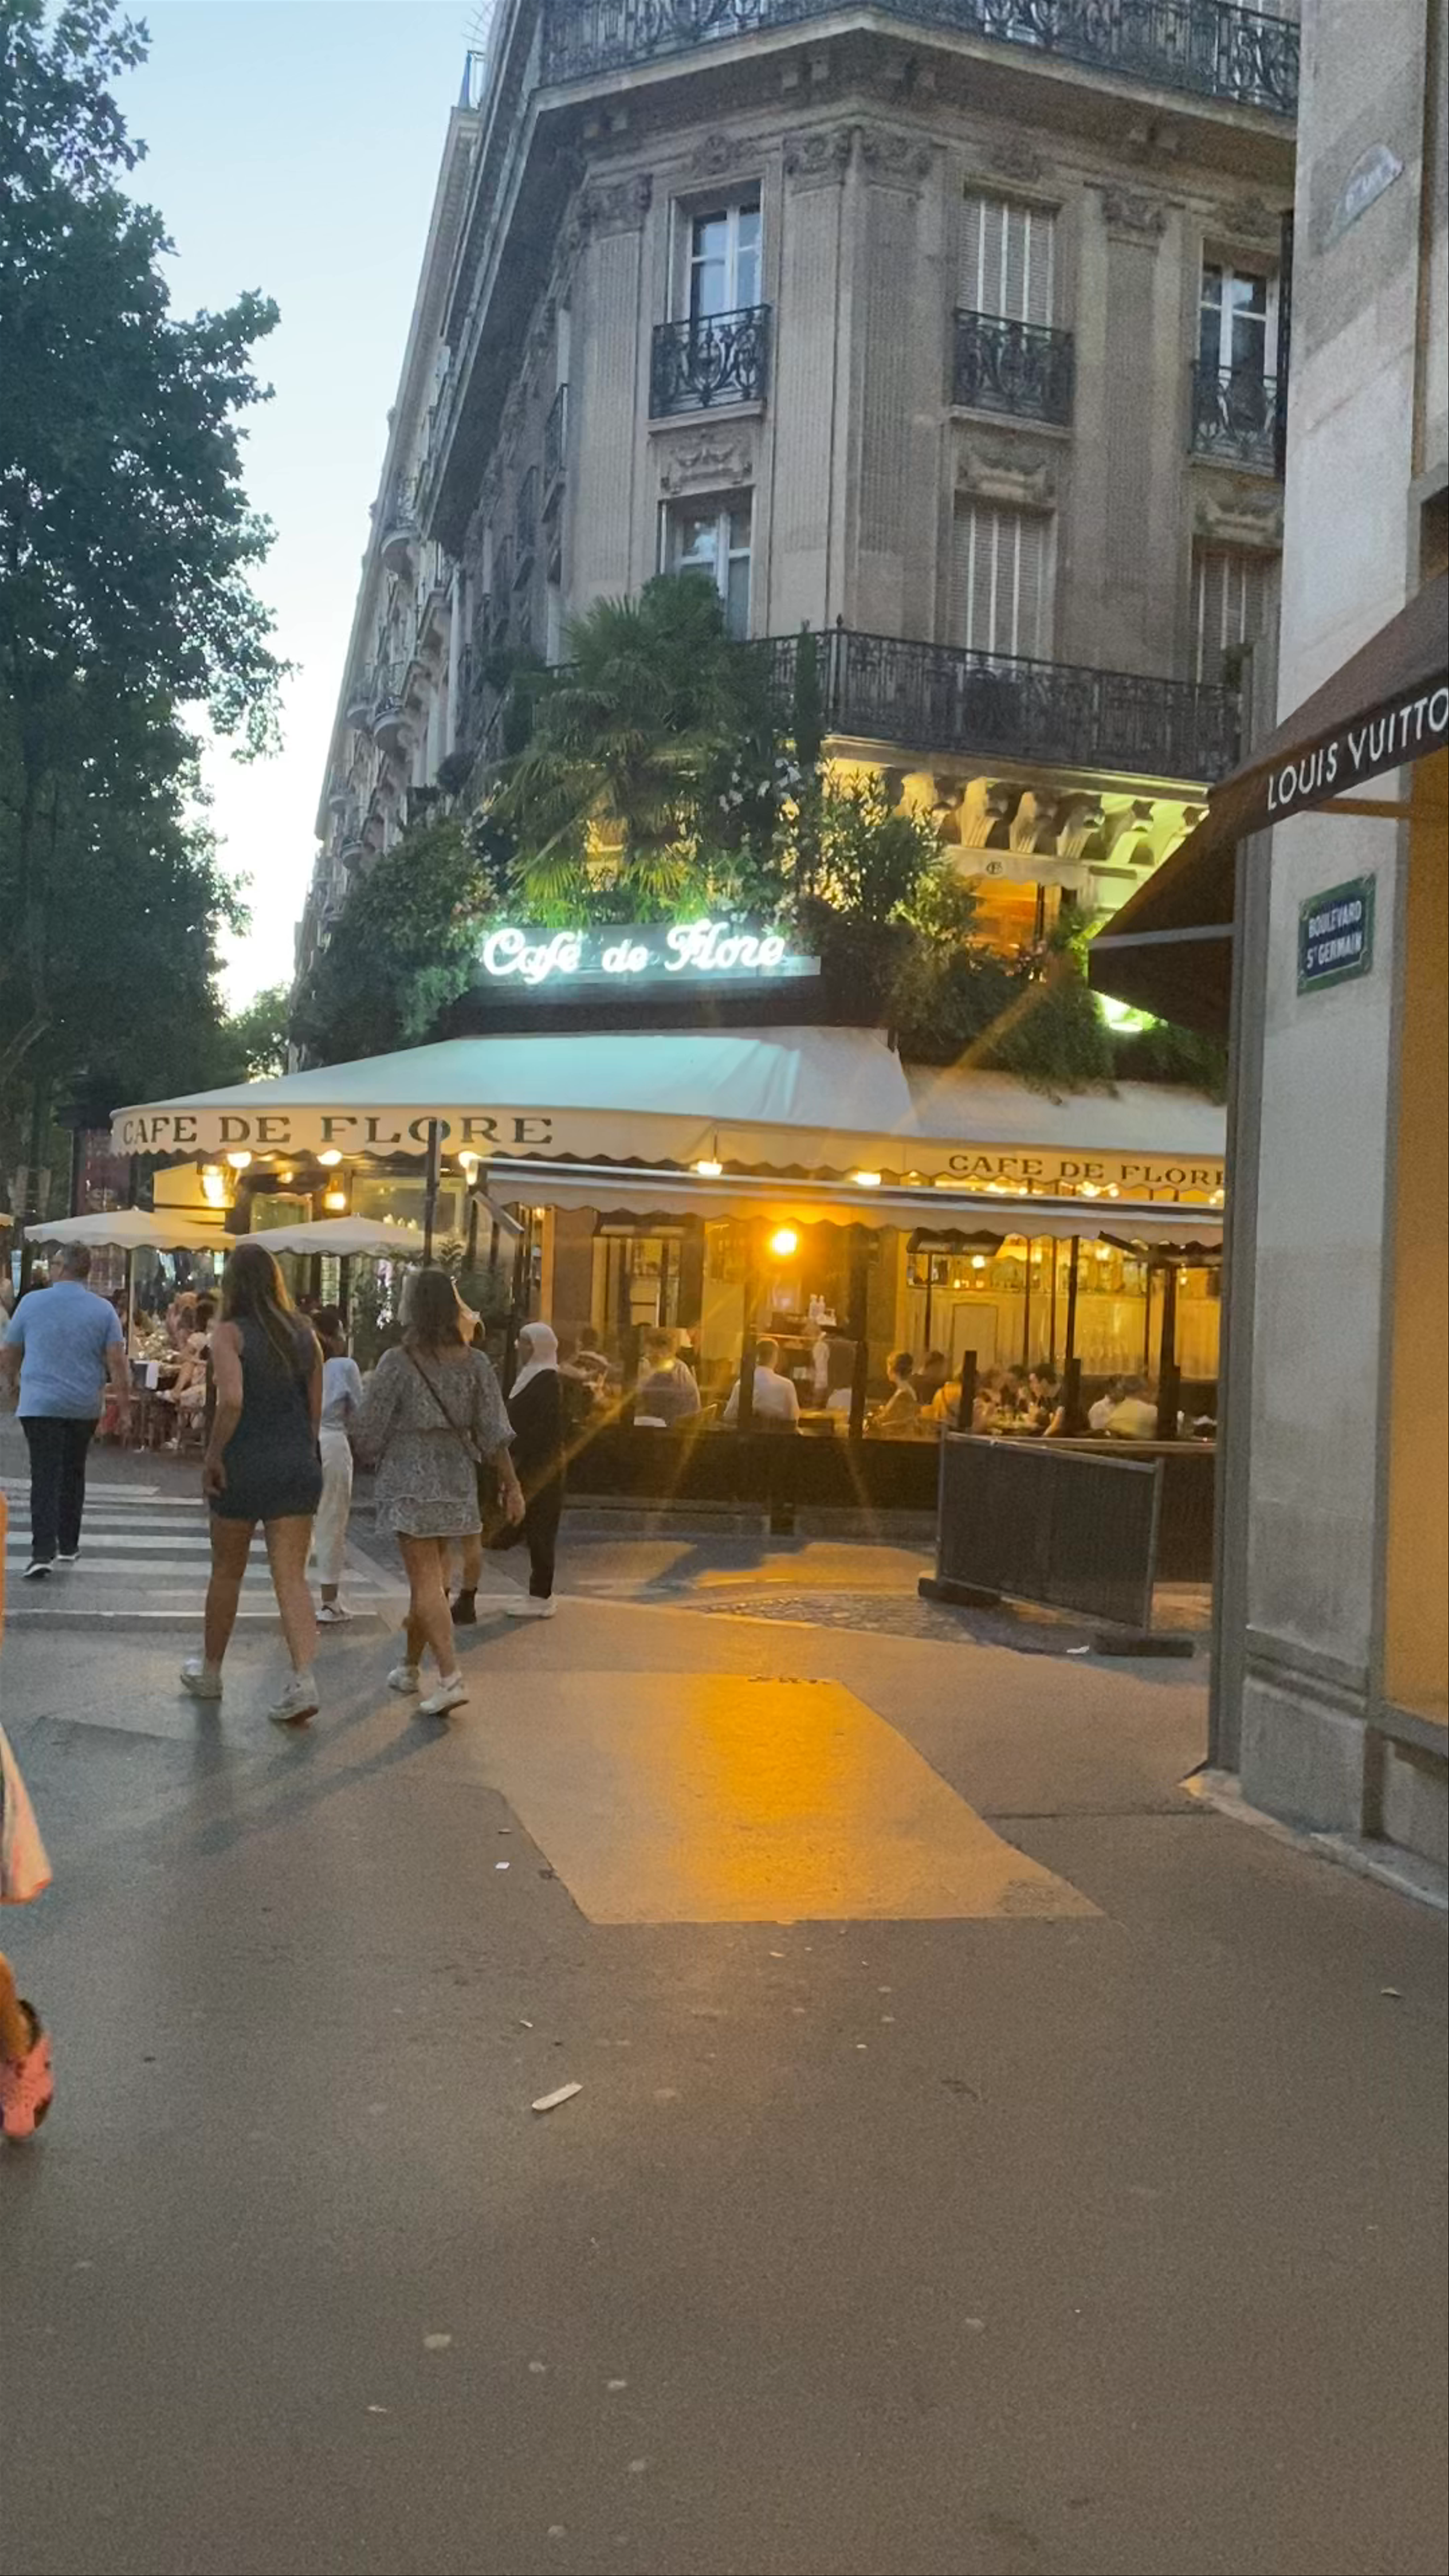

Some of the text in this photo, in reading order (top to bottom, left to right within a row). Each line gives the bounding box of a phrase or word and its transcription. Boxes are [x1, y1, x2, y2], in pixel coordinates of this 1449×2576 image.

[1268, 687, 1449, 810] LOUIS VUITTO
[1309, 900, 1362, 939] BOULEVARD
[601, 938, 649, 973] de
[664, 918, 785, 971] Flore
[1318, 931, 1362, 965] GERMAIN
[123, 1116, 553, 1145] CAFE DE FLORE
[949, 1155, 1043, 1175] CAFE
[1060, 1161, 1103, 1178] DE
